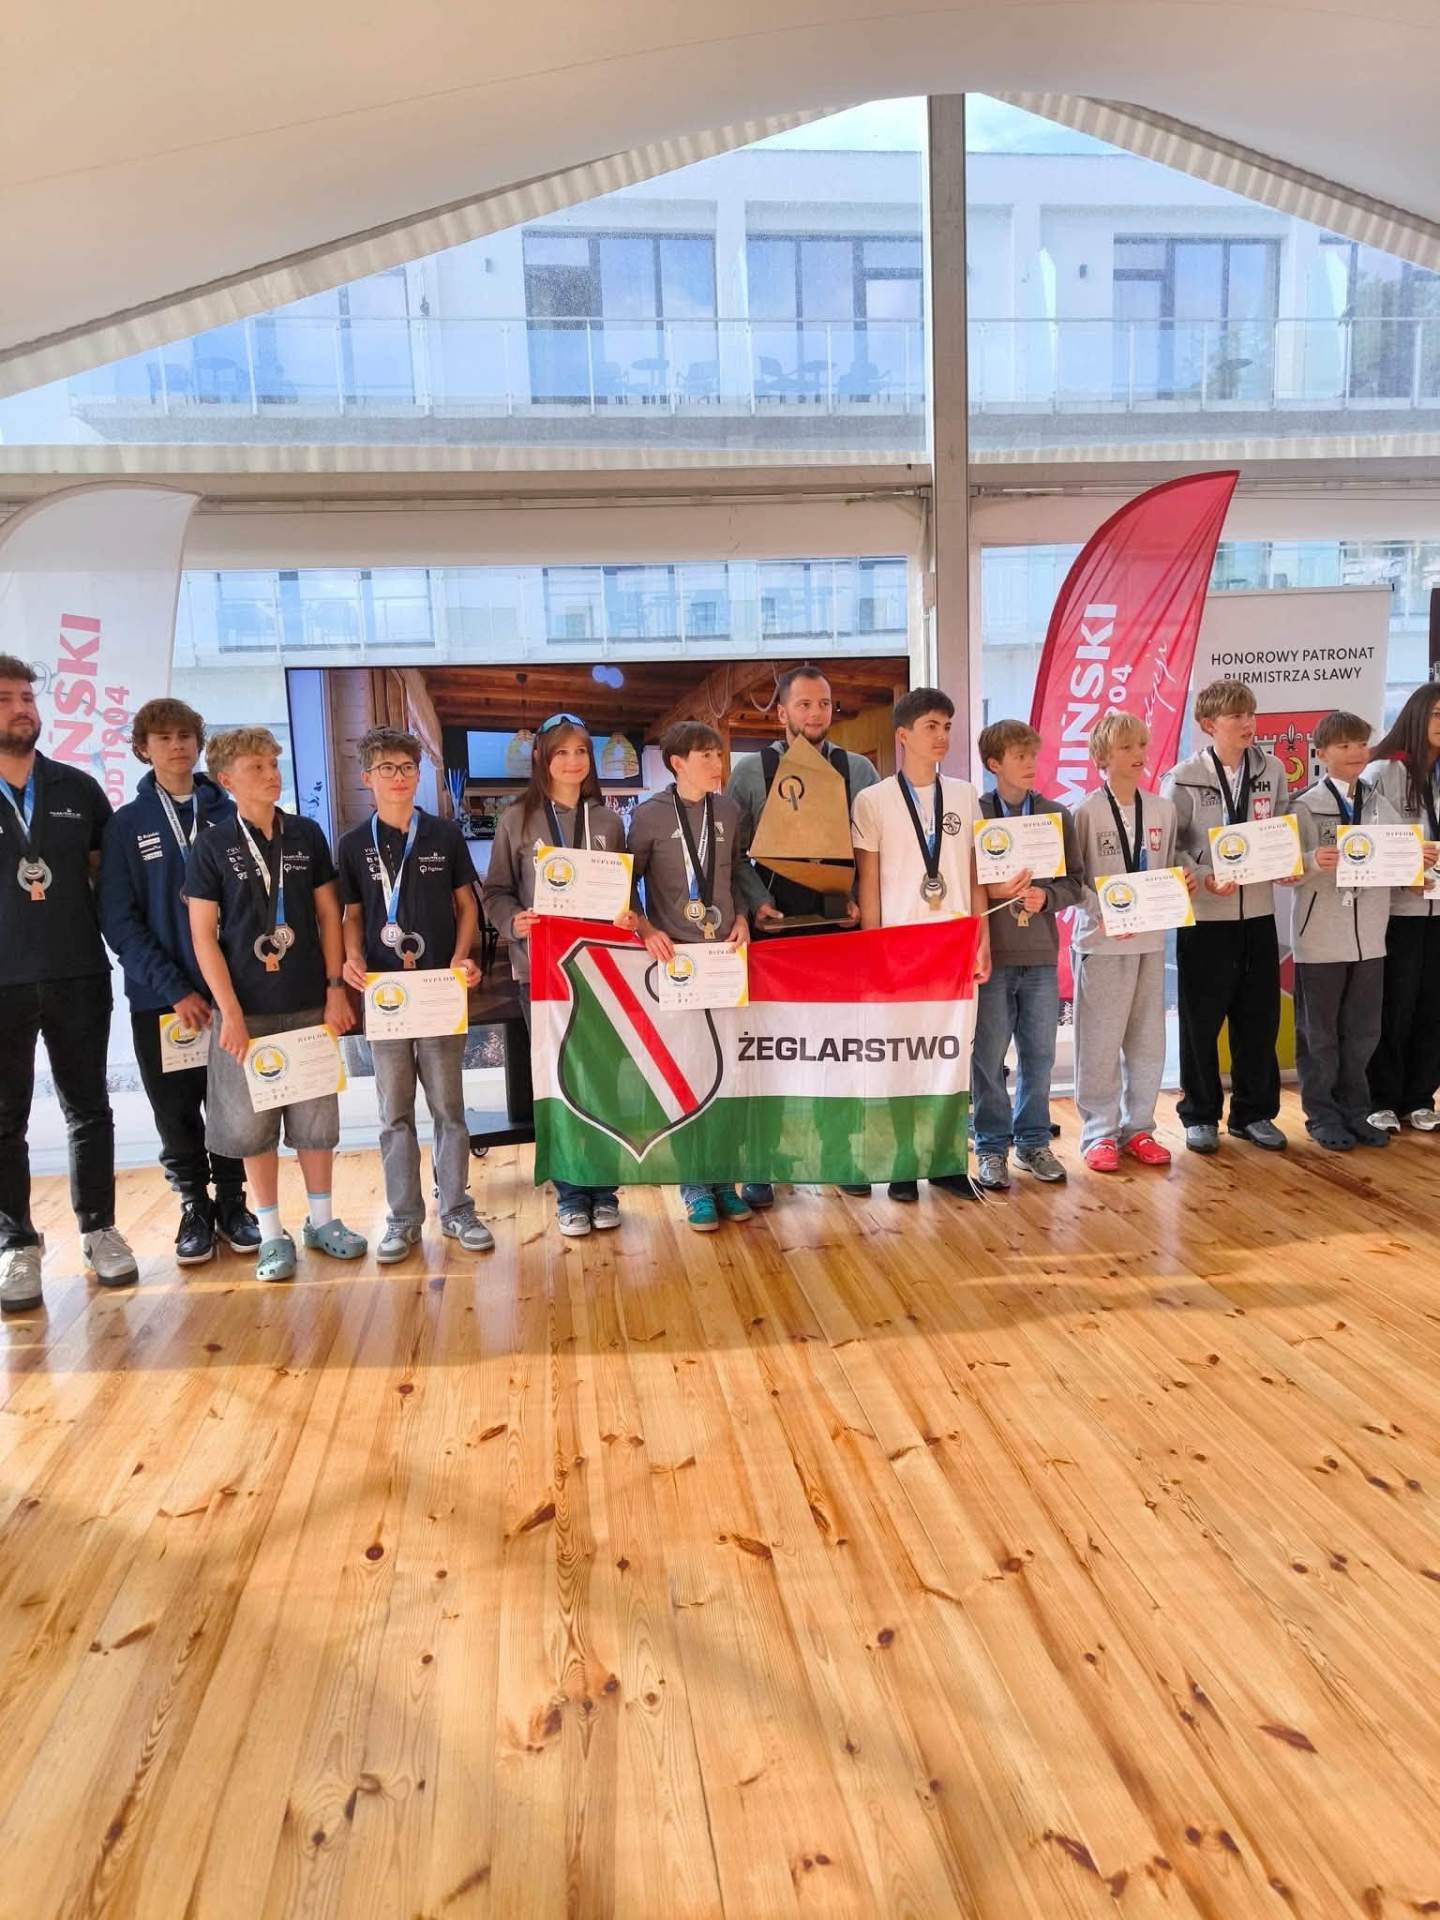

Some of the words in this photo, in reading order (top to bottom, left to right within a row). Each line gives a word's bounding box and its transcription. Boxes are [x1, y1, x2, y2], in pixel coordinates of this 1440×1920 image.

[1211, 650, 1298, 666] HONOROWY
[1302, 647, 1375, 662] PATRONAT
[49, 613, 101, 766] ŃSKI
[1313, 667, 1367, 681] SŁAWY
[101, 686, 130, 759] 1904
[738, 1031, 960, 1062] ŻEGLARSTWO
